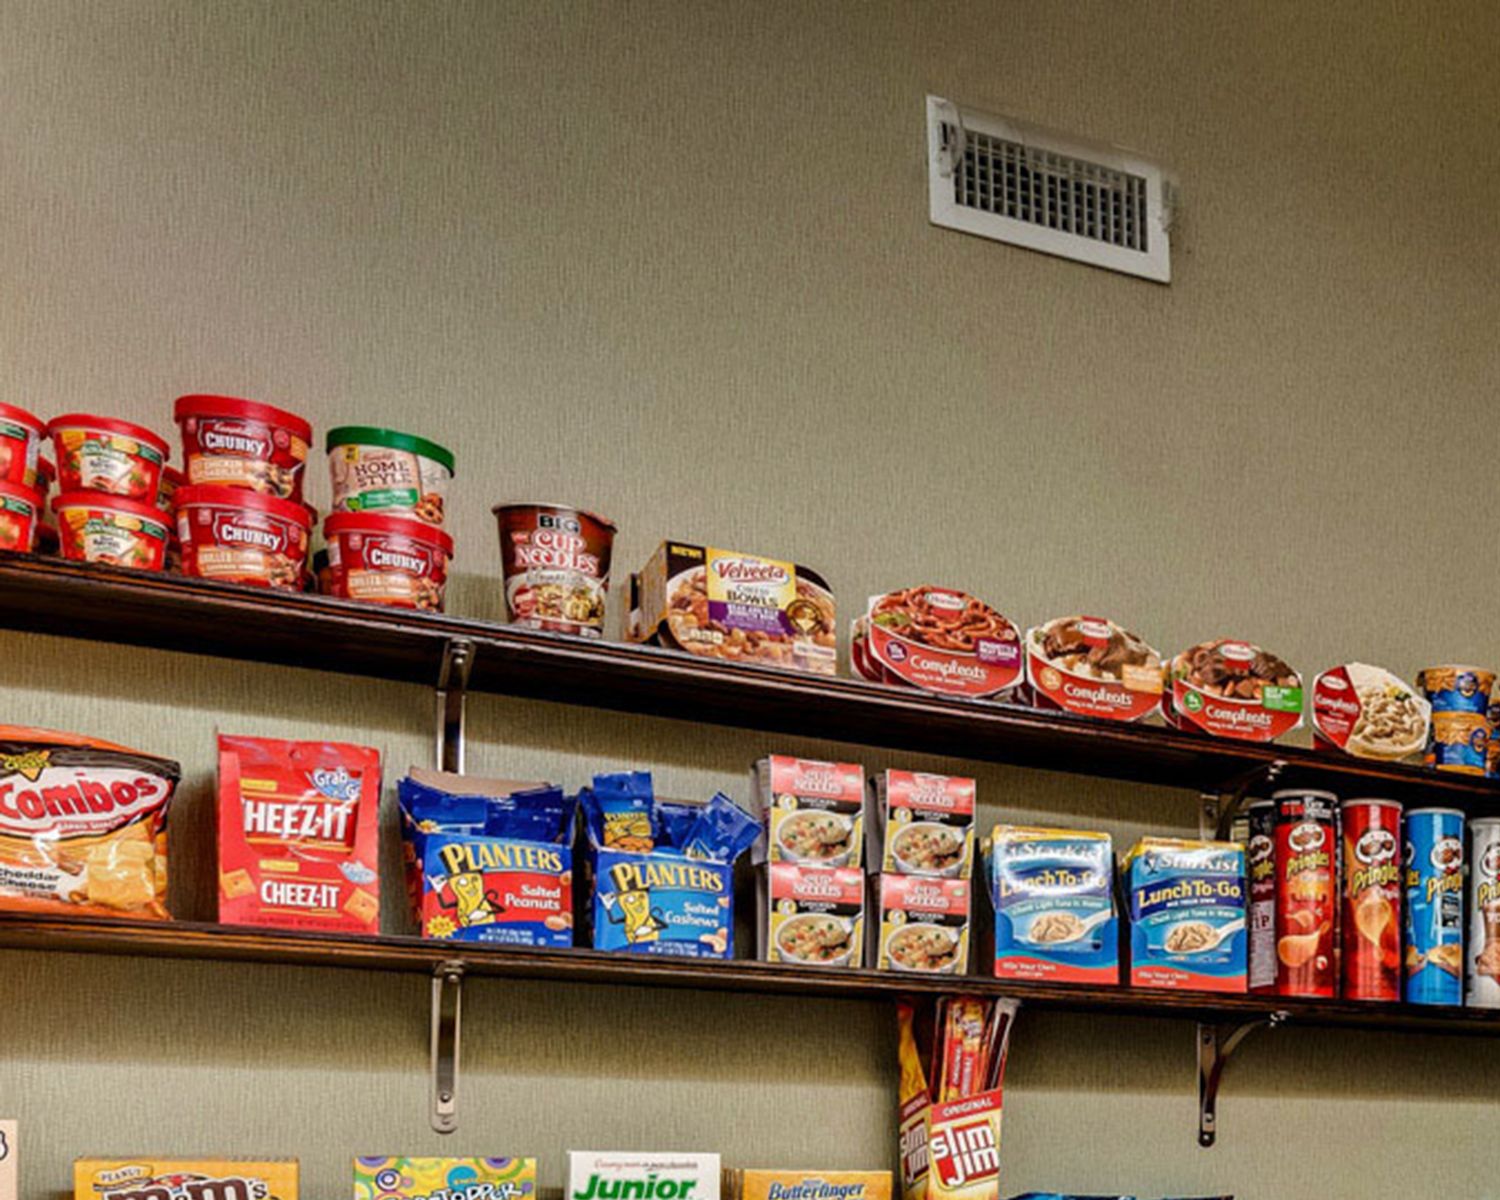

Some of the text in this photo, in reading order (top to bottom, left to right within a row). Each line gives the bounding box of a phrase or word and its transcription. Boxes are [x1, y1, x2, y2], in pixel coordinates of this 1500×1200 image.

[205, 431, 265, 455] CHUNKY
[355, 460, 412, 477] HOME
[356, 474, 413, 489] STYLE
[538, 513, 581, 535] BIG
[220, 524, 282, 552] CHUNKY
[532, 530, 584, 552] CUP
[370, 549, 428, 575] CHUNKY
[515, 546, 599, 575] NOODLES
[717, 560, 786, 580] Velveeta
[314, 768, 349, 787] Grab
[0, 775, 158, 820] Combos
[243, 799, 352, 843] HEEZ-IT
[442, 844, 564, 874] PLANTERS
[612, 861, 724, 893] PLANTERS
[261, 880, 340, 909] CHEEZ-IT
[521, 883, 562, 899] Salted
[504, 894, 561, 912] Peanuts
[683, 901, 720, 918] Salted
[665, 910, 720, 929] Cashews
[942, 1097, 994, 1118] ORIGINAL
[100, 1167, 142, 1183] PEANUT
[768, 1182, 866, 1200] Butterfinger
